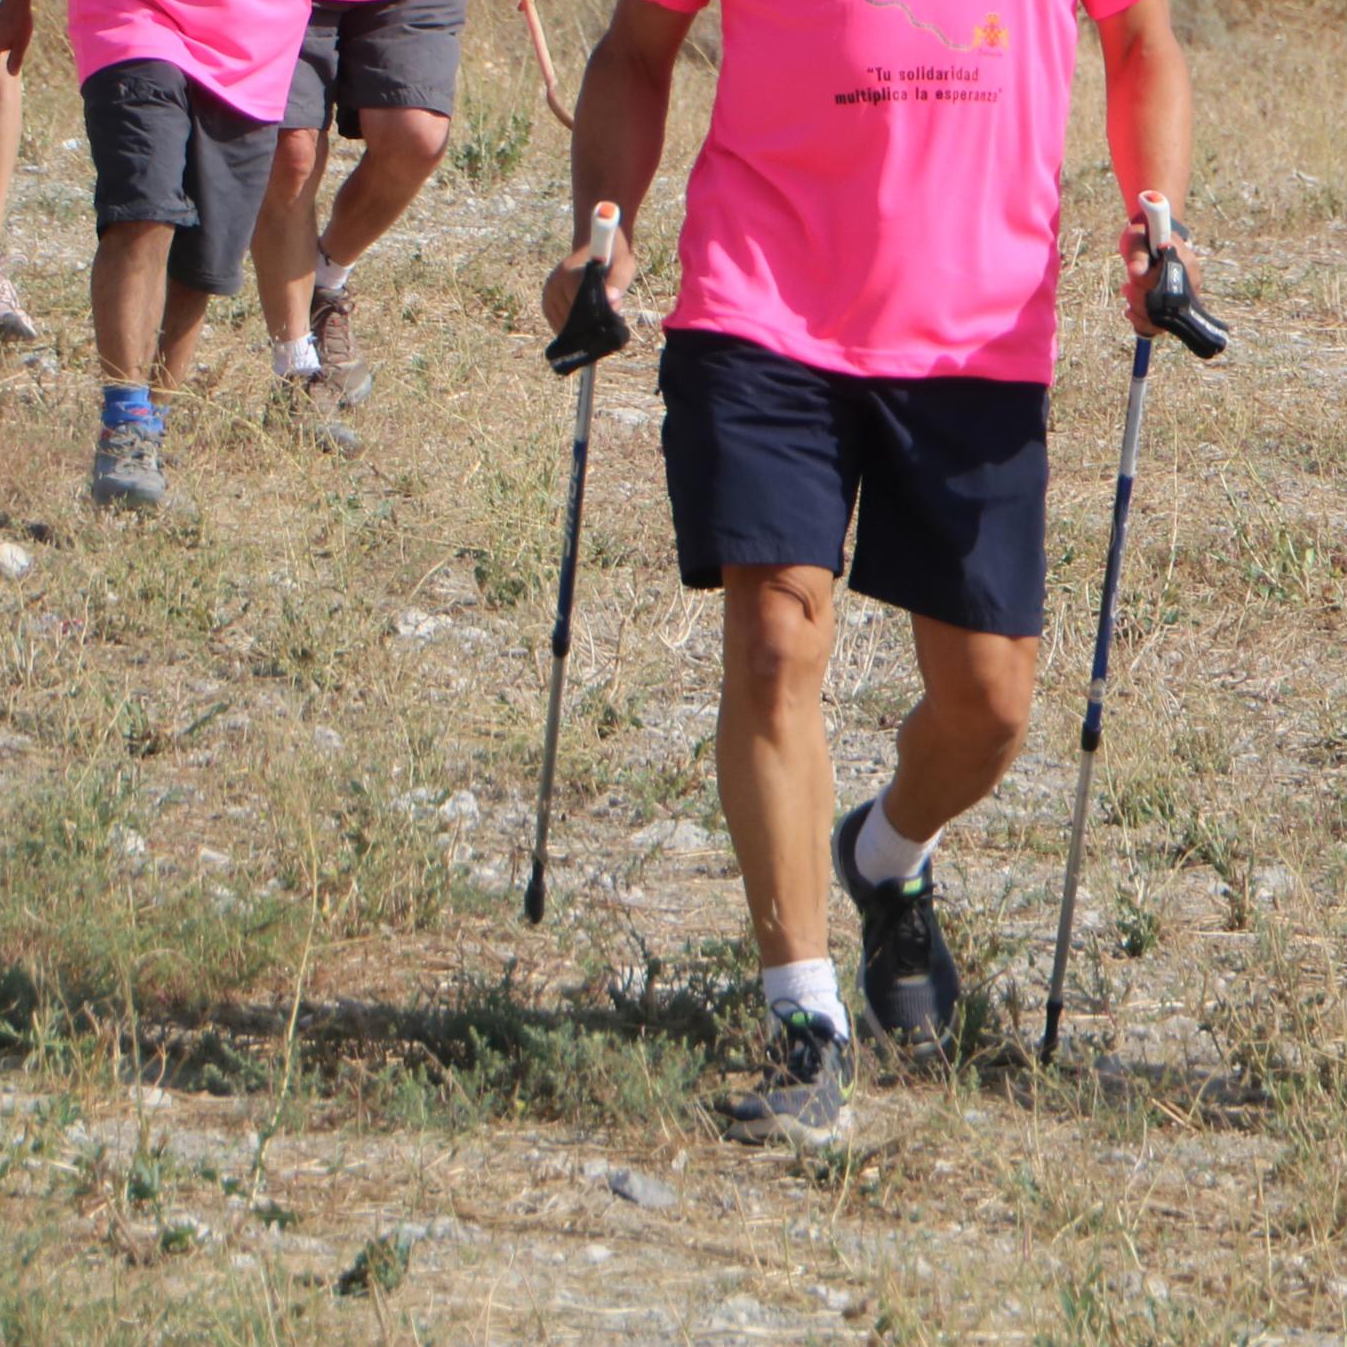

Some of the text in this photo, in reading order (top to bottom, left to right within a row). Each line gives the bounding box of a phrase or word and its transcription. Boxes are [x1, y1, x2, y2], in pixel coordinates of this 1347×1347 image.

[899, 65, 979, 82] solidaridad
[834, 86, 908, 106] multiplica
[914, 86, 929, 101] la
